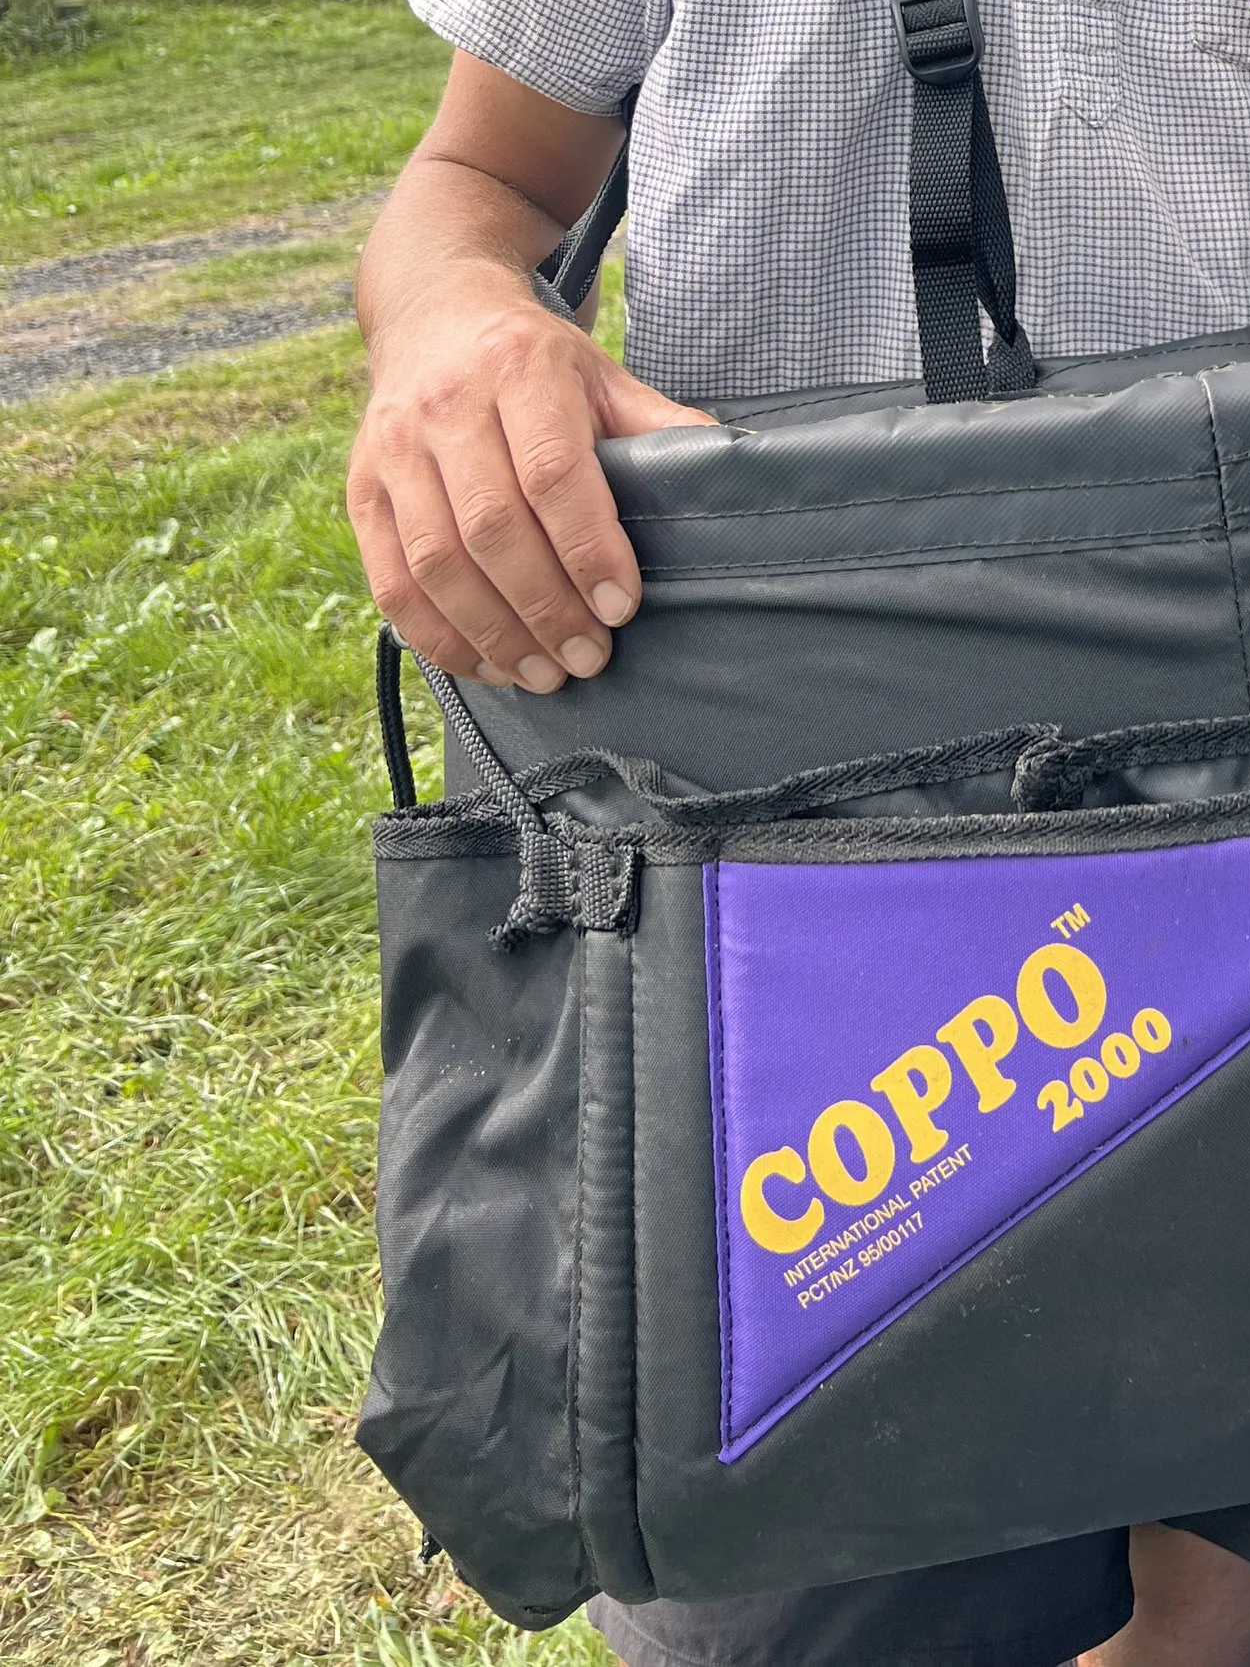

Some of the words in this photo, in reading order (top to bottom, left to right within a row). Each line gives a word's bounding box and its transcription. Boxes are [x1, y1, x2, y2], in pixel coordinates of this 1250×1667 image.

[740, 942, 1107, 1254] COPPO
[1037, 1007, 1172, 1133] 2000
[783, 1192, 911, 1287] INTERNATIONAL
[909, 1143, 974, 1198] PATENT
[797, 1257, 860, 1309] PCT/NZ
[858, 1212, 925, 1268] 95/00117
